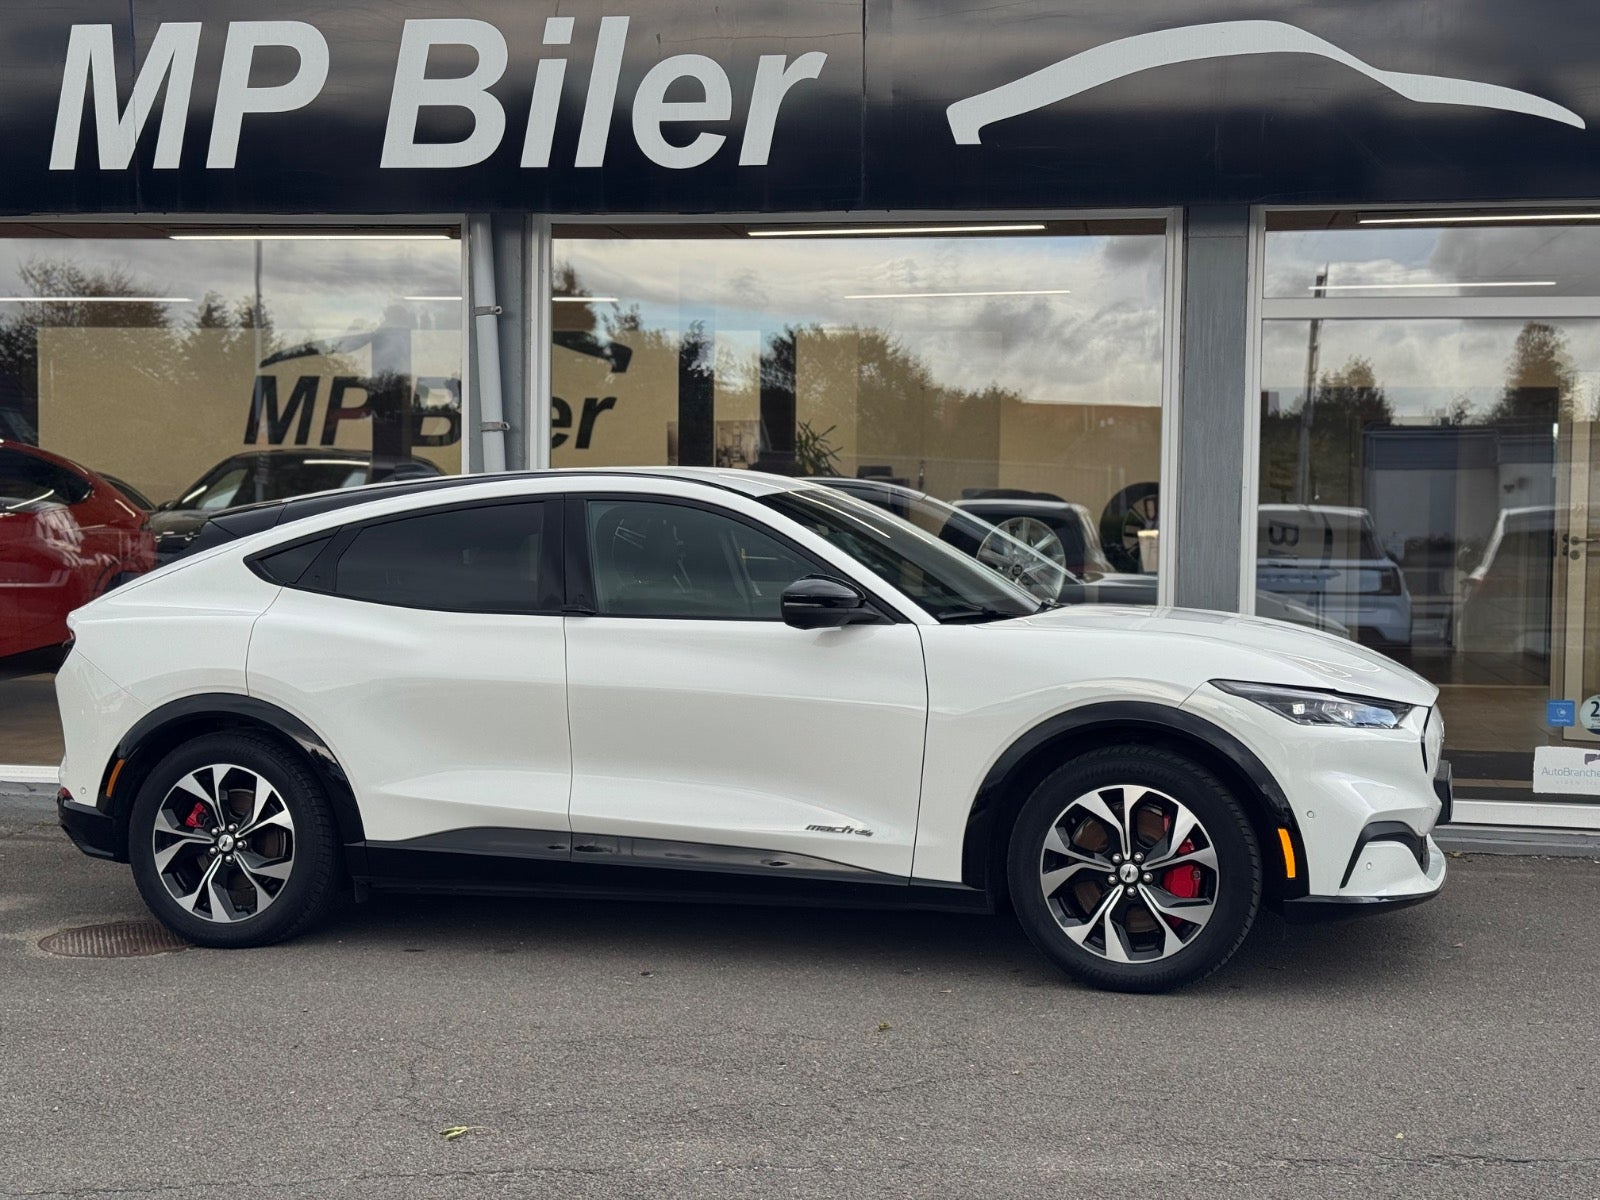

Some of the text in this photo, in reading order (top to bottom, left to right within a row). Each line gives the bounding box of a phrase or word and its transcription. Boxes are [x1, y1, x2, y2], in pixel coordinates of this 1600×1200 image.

[49, 15, 828, 170] MP Biler
[243, 374, 380, 447] MP
